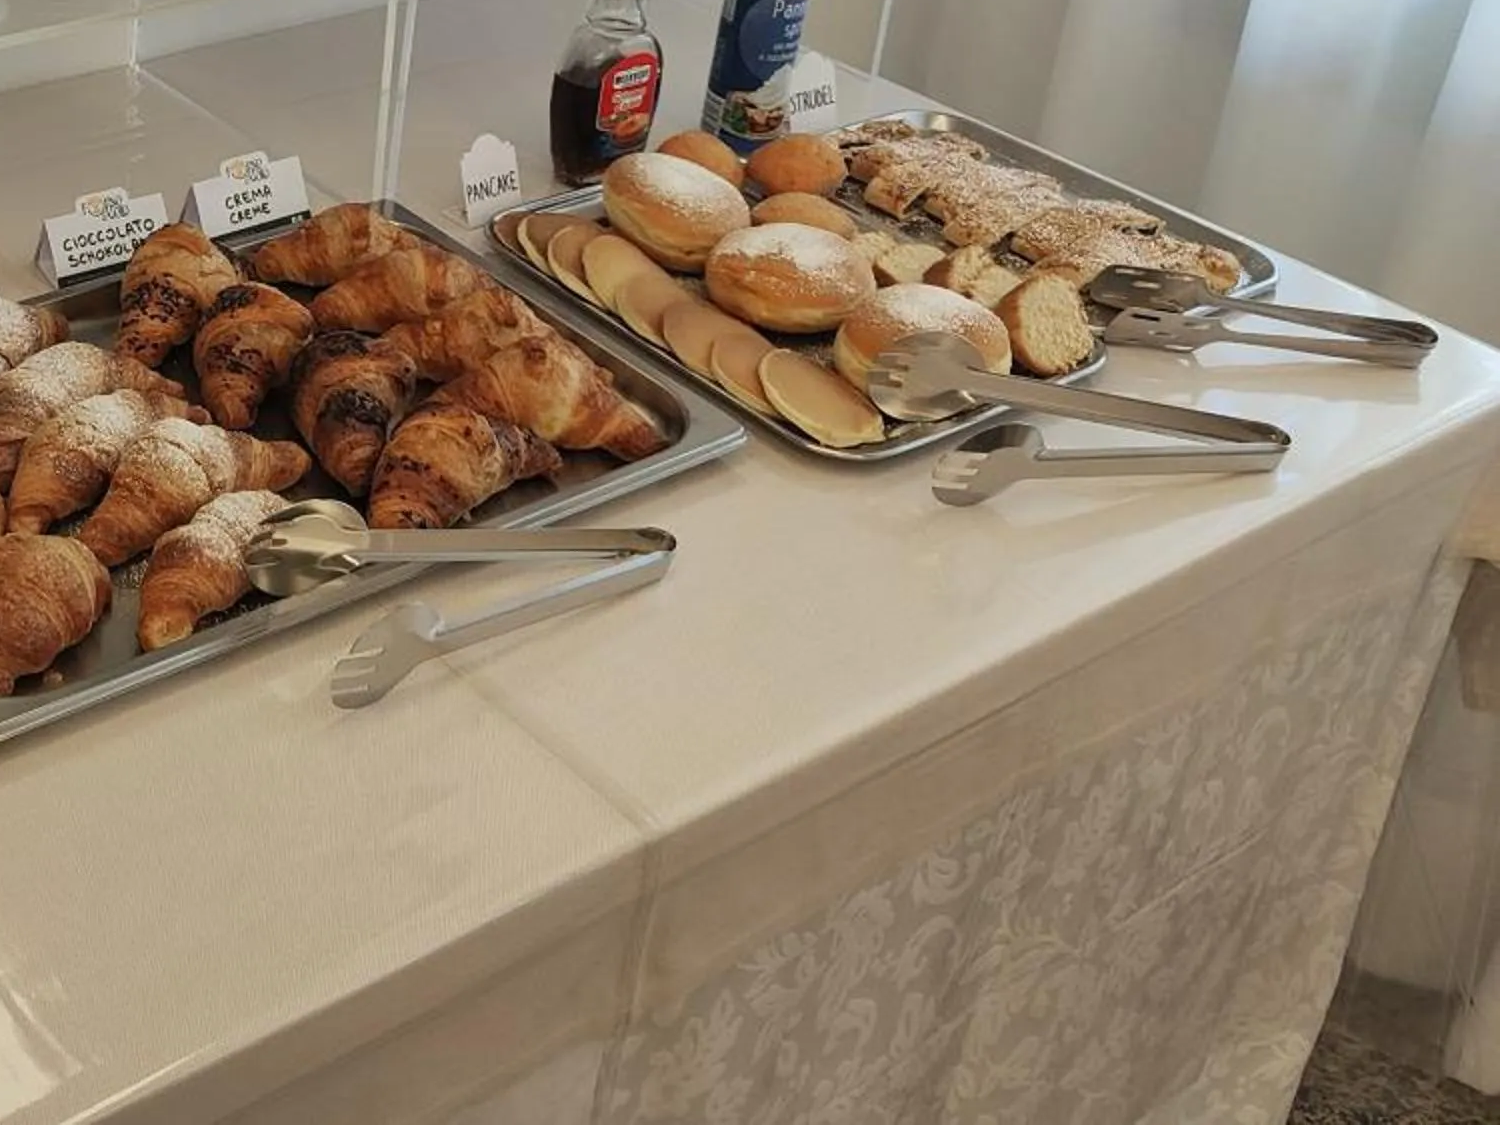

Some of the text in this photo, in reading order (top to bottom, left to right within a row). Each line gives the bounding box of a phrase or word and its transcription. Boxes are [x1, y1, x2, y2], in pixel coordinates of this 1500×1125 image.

[789, 83, 836, 116] STRUDEL
[225, 184, 272, 211] CREMA
[466, 169, 519, 204] PANCAKE
[63, 218, 155, 252] CIOCCOLATO
